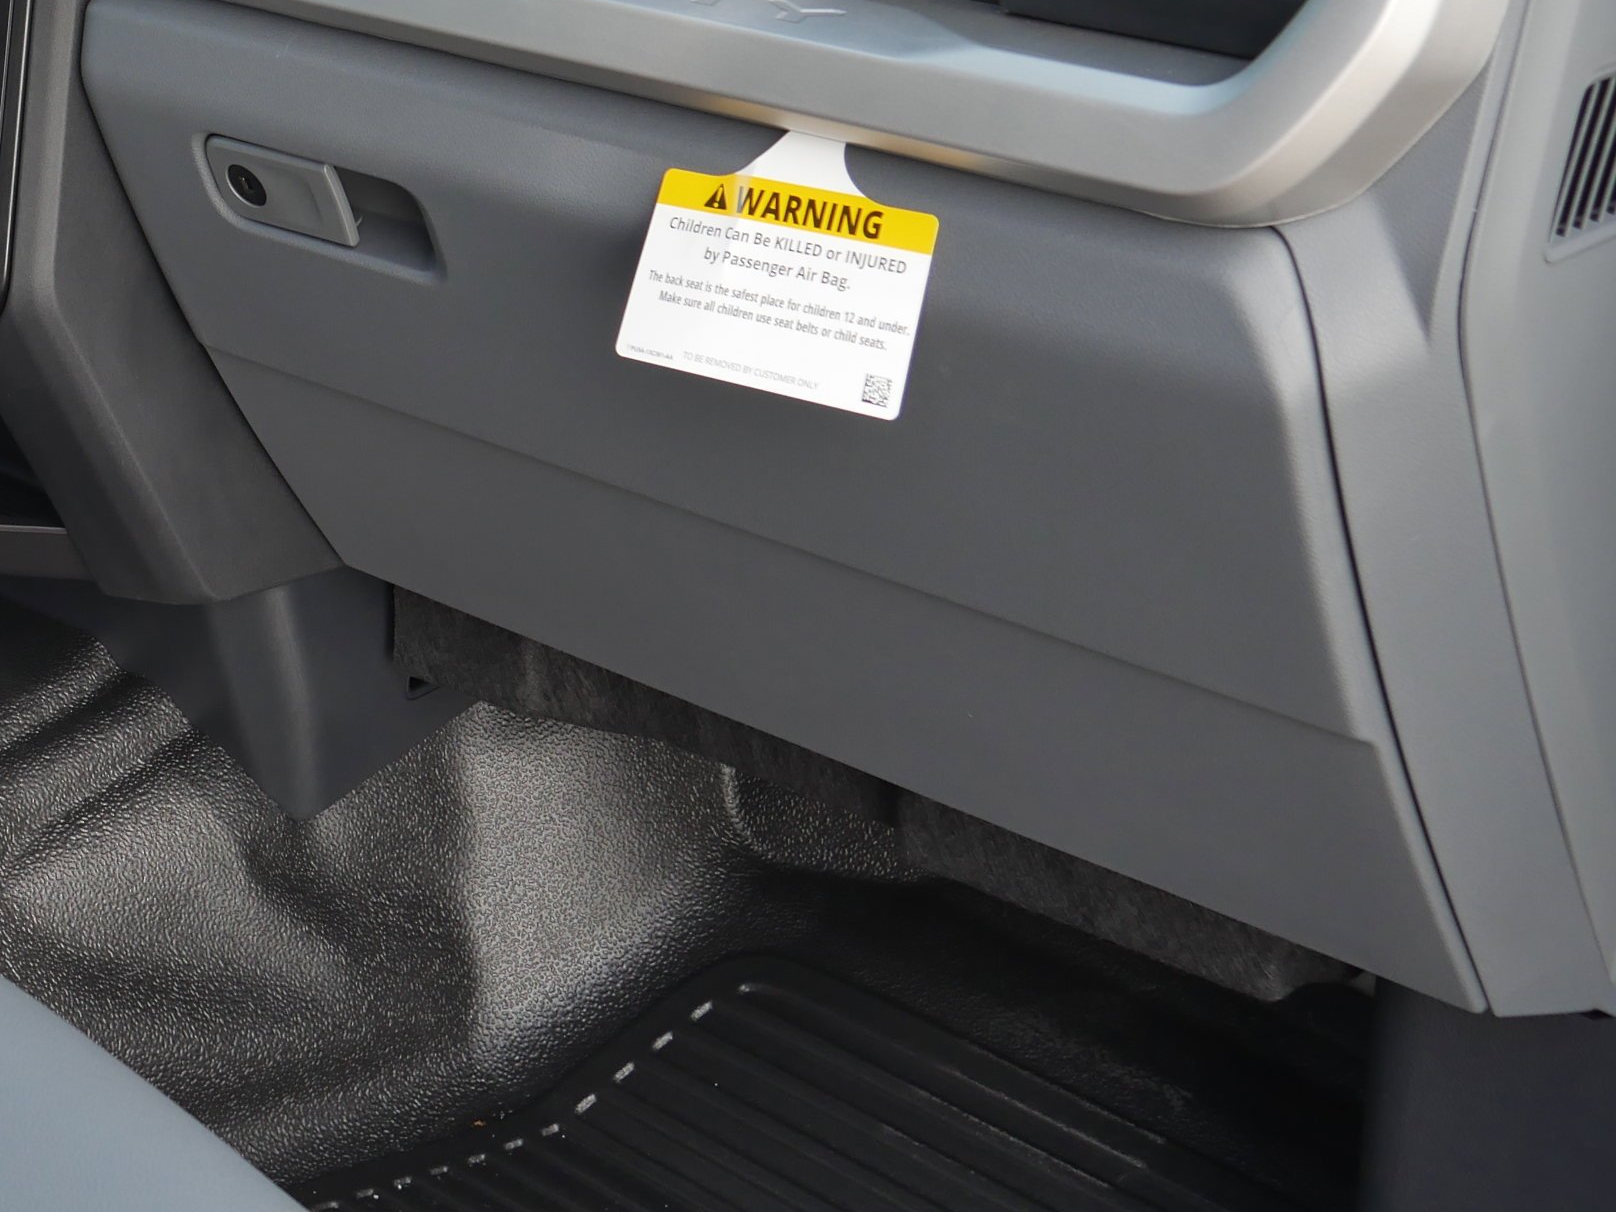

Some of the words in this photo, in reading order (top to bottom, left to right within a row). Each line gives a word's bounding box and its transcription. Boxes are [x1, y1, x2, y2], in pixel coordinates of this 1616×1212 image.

[737, 186, 884, 239] WARNING
[669, 216, 722, 240] Children
[725, 226, 750, 244] Can
[754, 232, 771, 248] Be
[774, 236, 823, 258] KILLED
[826, 248, 842, 262] or
[845, 250, 907, 275] INJURED
[704, 247, 719, 265] by
[722, 250, 793, 279] Passenger
[796, 266, 817, 282] Air
[821, 271, 851, 292] Bag.
[648, 269, 664, 282] The
[665, 273, 684, 287] back
[686, 278, 704, 291] seat
[705, 281, 713, 293] is
[714, 284, 730, 297] the
[731, 288, 759, 304] safest
[760, 293, 785, 309] place
[787, 298, 802, 312] for
[803, 303, 841, 320] children
[845, 311, 855, 324] 12
[857, 315, 876, 328] and
[878, 320, 910, 337] under.
[658, 290, 683, 305] Make
[683, 297, 702, 310] sure
[703, 300, 715, 312] all
[716, 303, 754, 321] children
[755, 313, 772, 325] use
[774, 316, 794, 330] seat
[795, 320, 819, 336] belts
[821, 328, 833, 338] or
[834, 329, 858, 344] child
[859, 336, 888, 351] seats.
[683, 350, 694, 362] TO
[694, 353, 705, 365] BE
[705, 355, 742, 373] REMOVED
[742, 363, 754, 375] BY
[753, 367, 797, 386] CUSTOMER
[797, 377, 820, 391] ONLY
